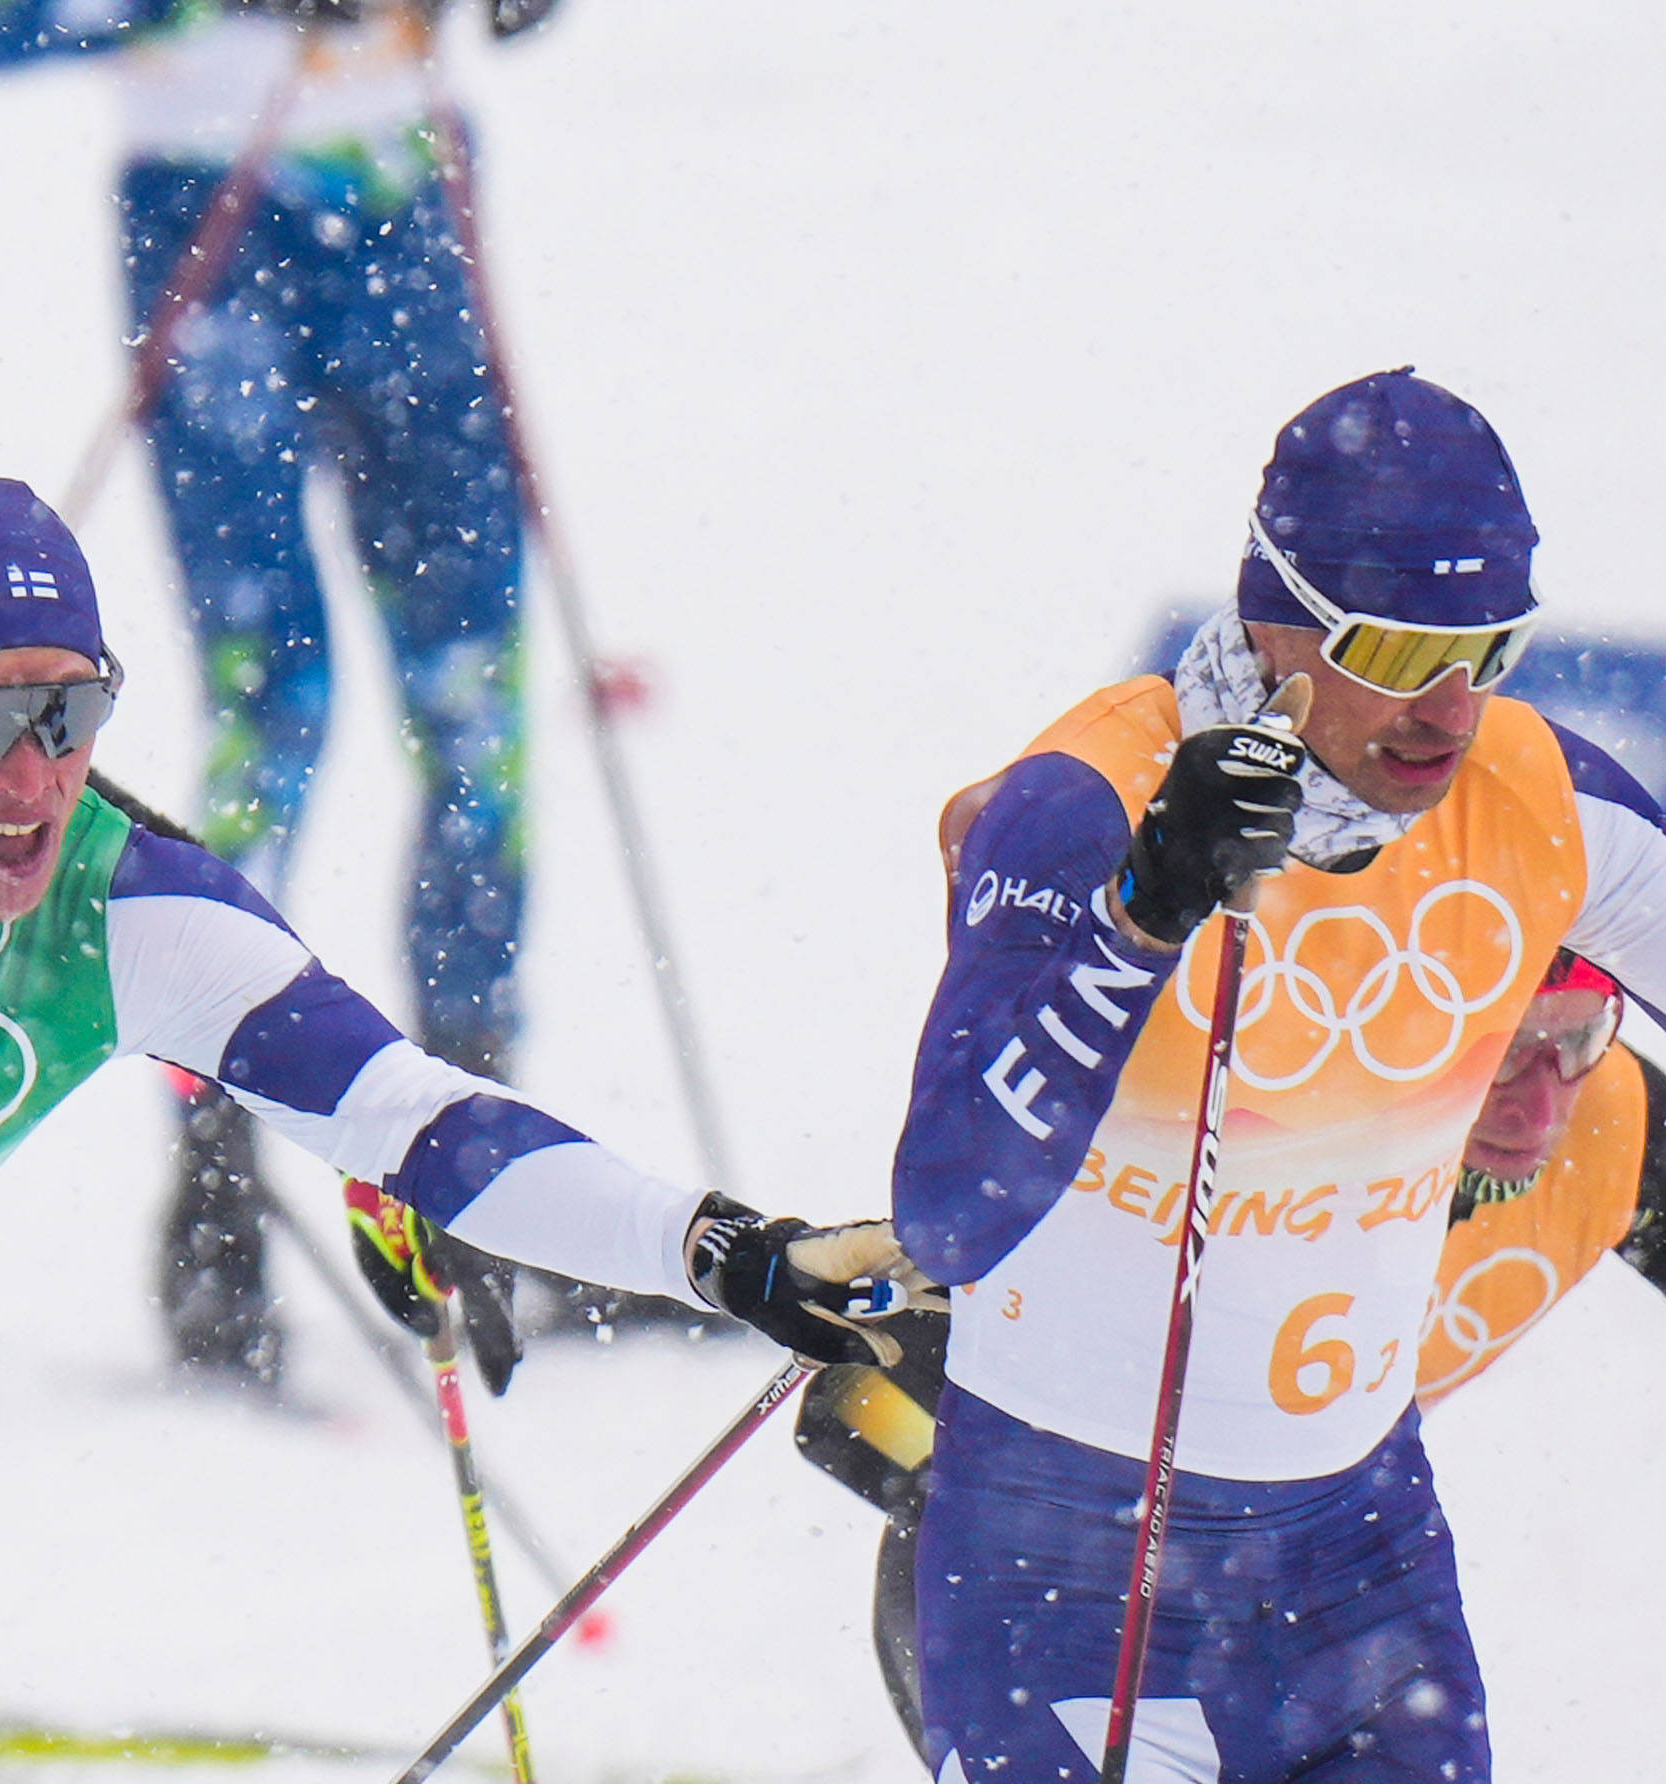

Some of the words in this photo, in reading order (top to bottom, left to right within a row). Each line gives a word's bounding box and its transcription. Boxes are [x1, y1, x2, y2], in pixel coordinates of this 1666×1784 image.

[1000, 876, 1083, 927] HALT
[1002, 1289, 1023, 1321] 3
[1268, 1292, 1356, 1415] 6
